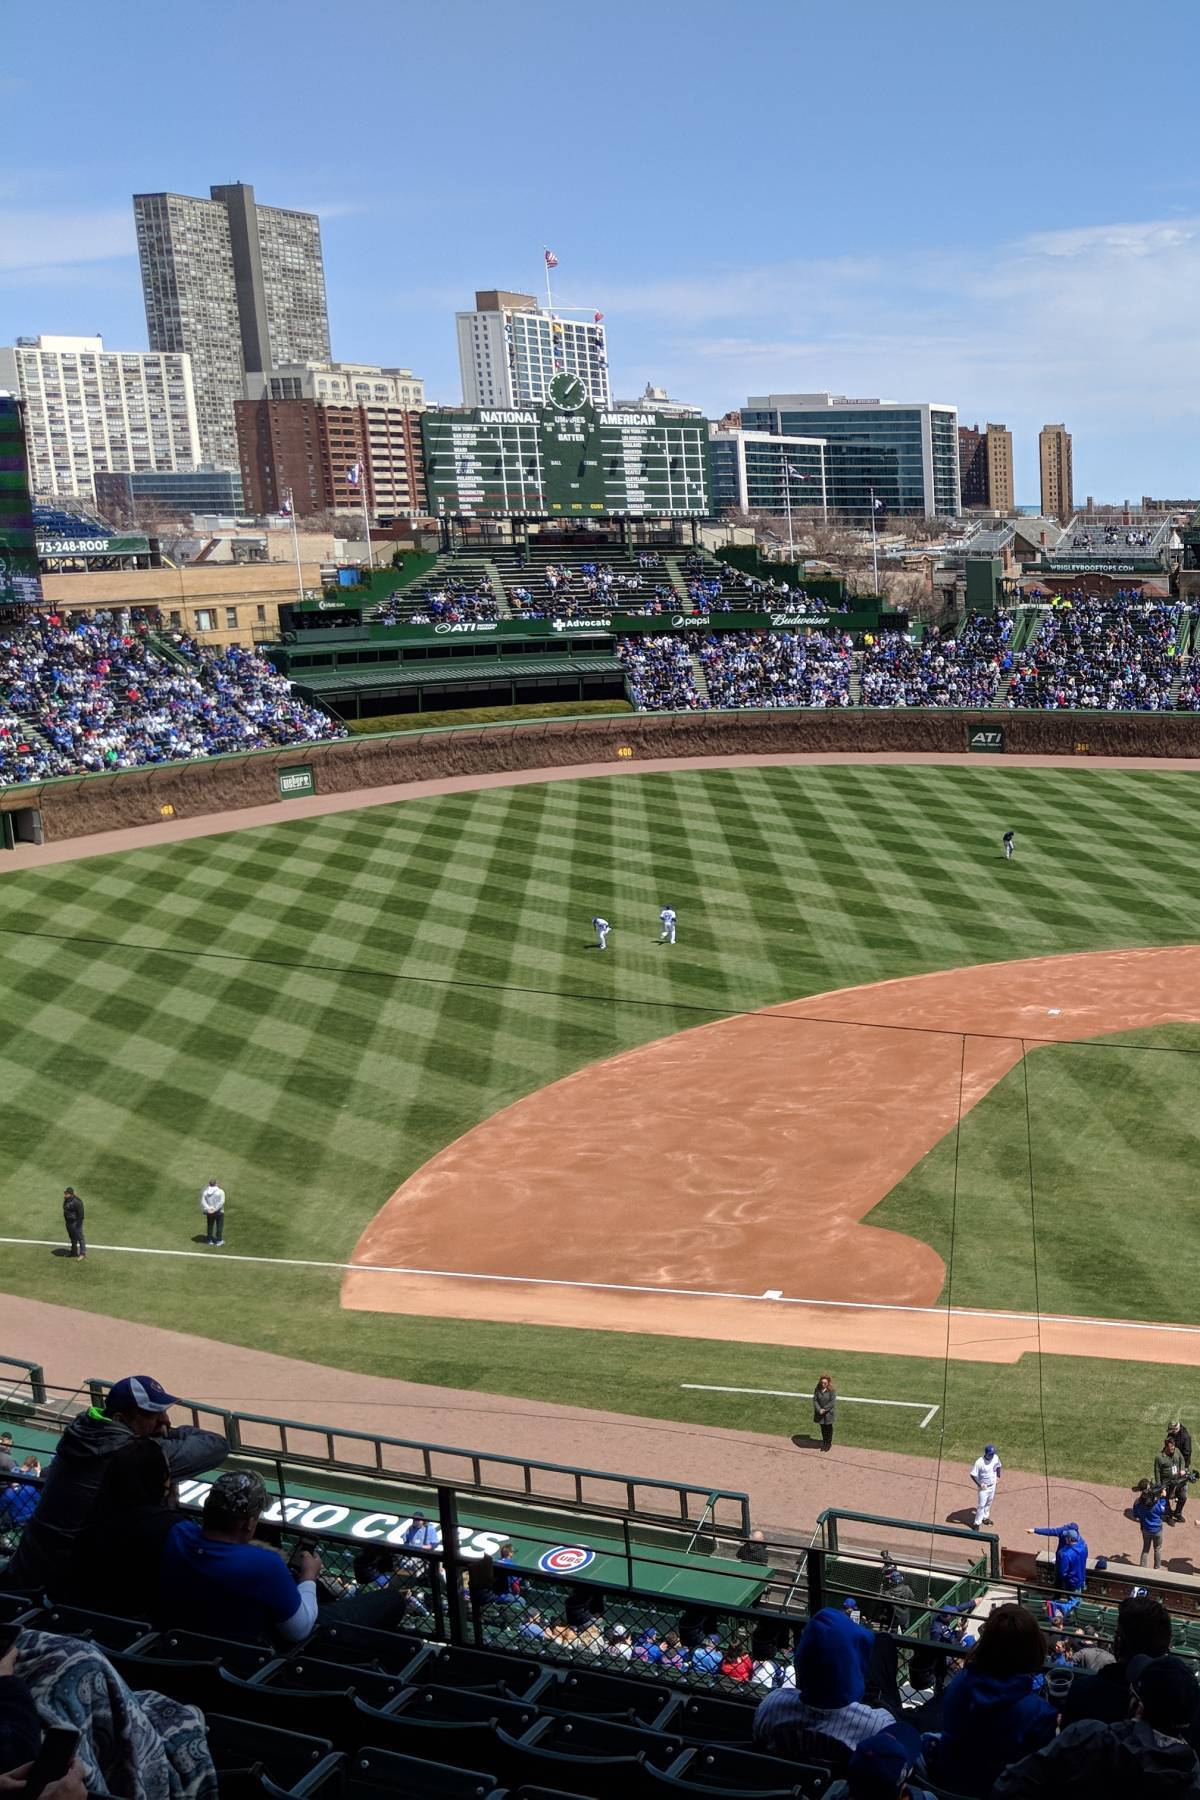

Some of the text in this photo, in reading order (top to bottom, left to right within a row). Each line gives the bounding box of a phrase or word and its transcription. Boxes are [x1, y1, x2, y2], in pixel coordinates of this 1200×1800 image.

[480, 411, 540, 424] NATIONAL
[600, 413, 655, 425] AMERICAN
[557, 433, 585, 442] BATTER
[566, 619, 611, 628] Advocate
[685, 616, 710, 627] pepsi
[770, 613, 831, 626] Budweiser
[451, 623, 476, 632] ATI
[971, 732, 1002, 743] ATI
[617, 746, 632, 757] 400
